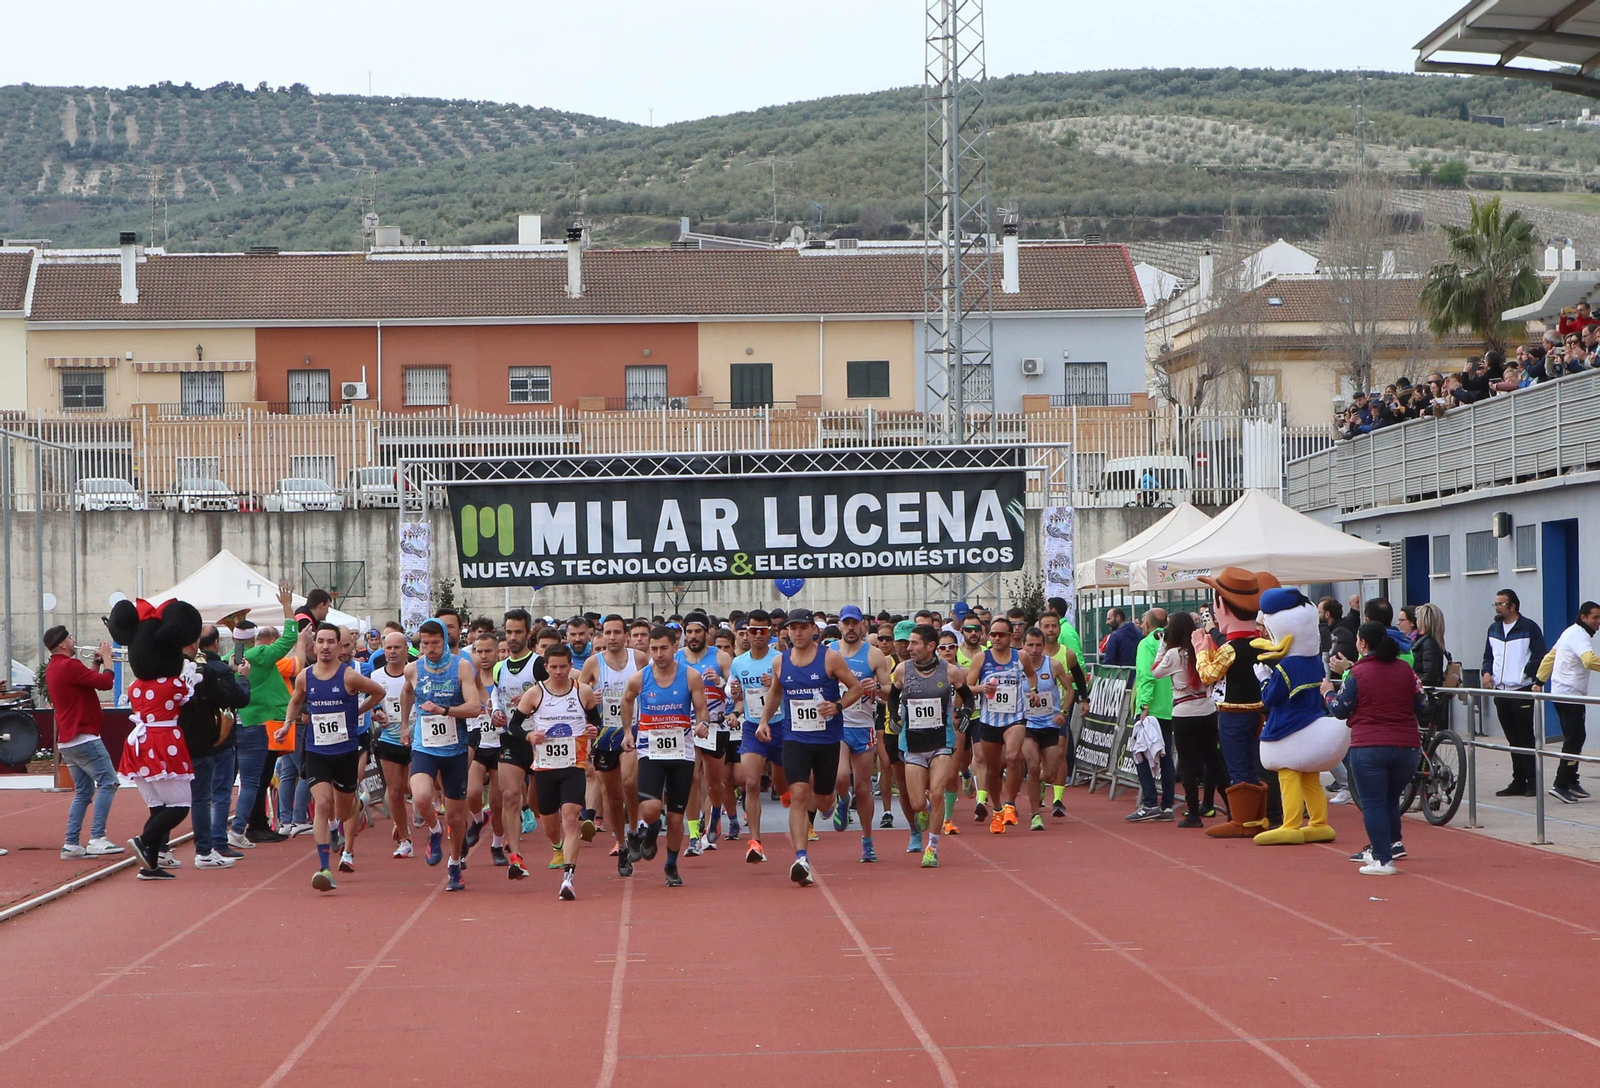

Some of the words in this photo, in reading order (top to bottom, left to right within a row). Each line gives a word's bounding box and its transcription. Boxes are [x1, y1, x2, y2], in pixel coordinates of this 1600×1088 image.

[530, 499, 740, 555] MILAR
[763, 489, 1012, 549] LUCENA
[462, 561, 555, 579] NUEVAS
[562, 553, 728, 576] TECNOLOGÍAS
[730, 552, 754, 576] &
[755, 546, 1014, 571] ELECTRODOMÉSTICOS
[996, 693, 1008, 703] 89
[1029, 698, 1047, 708] 89
[797, 707, 817, 720] 916
[915, 706, 934, 718] 610
[319, 721, 339, 734] 616
[431, 723, 447, 736] 30
[656, 736, 677, 749] 361
[546, 744, 569, 757] 933
